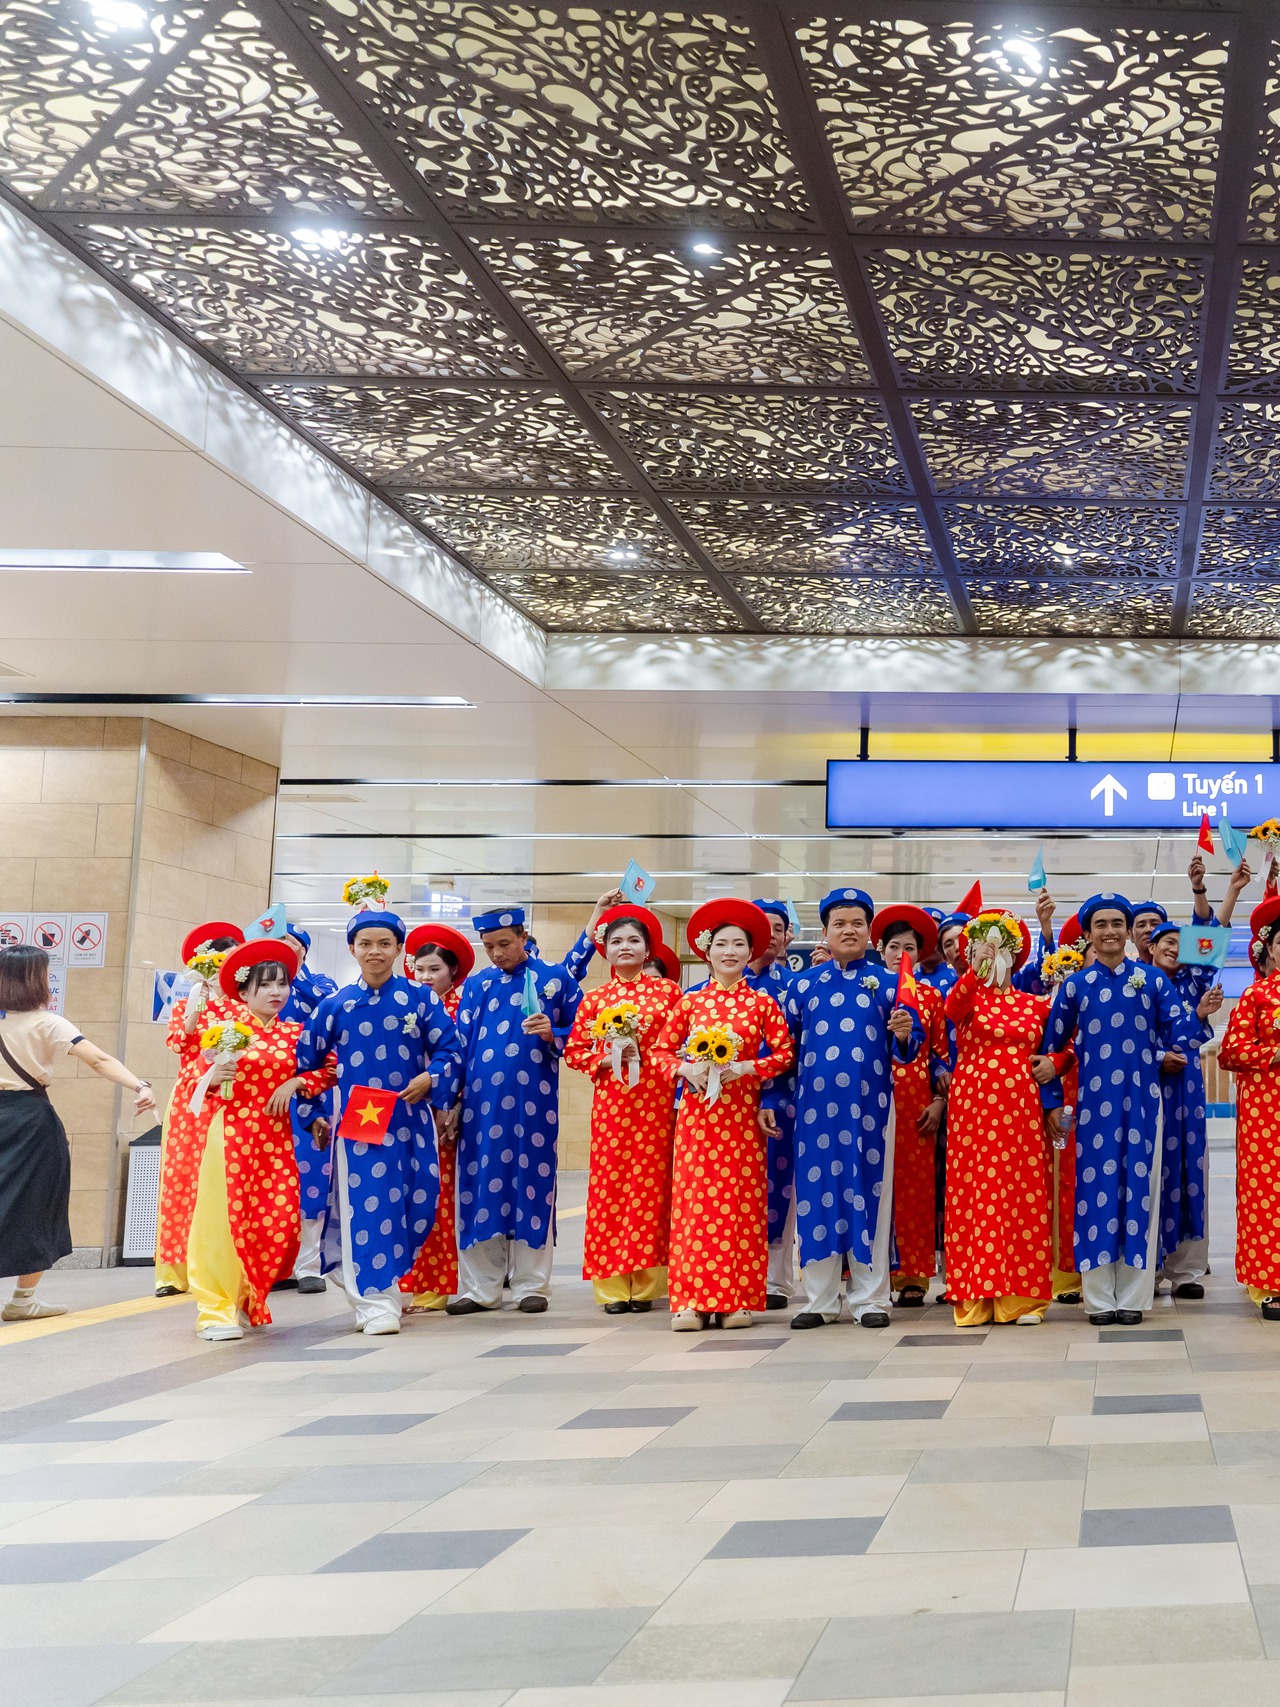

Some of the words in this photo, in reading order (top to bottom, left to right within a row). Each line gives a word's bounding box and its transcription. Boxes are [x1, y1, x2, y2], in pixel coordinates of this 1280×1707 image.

[1182, 771, 1248, 799] Tuyến
[1254, 773, 1263, 795] 1
[1182, 801, 1217, 817] Line
[1220, 801, 1228, 817] 1
